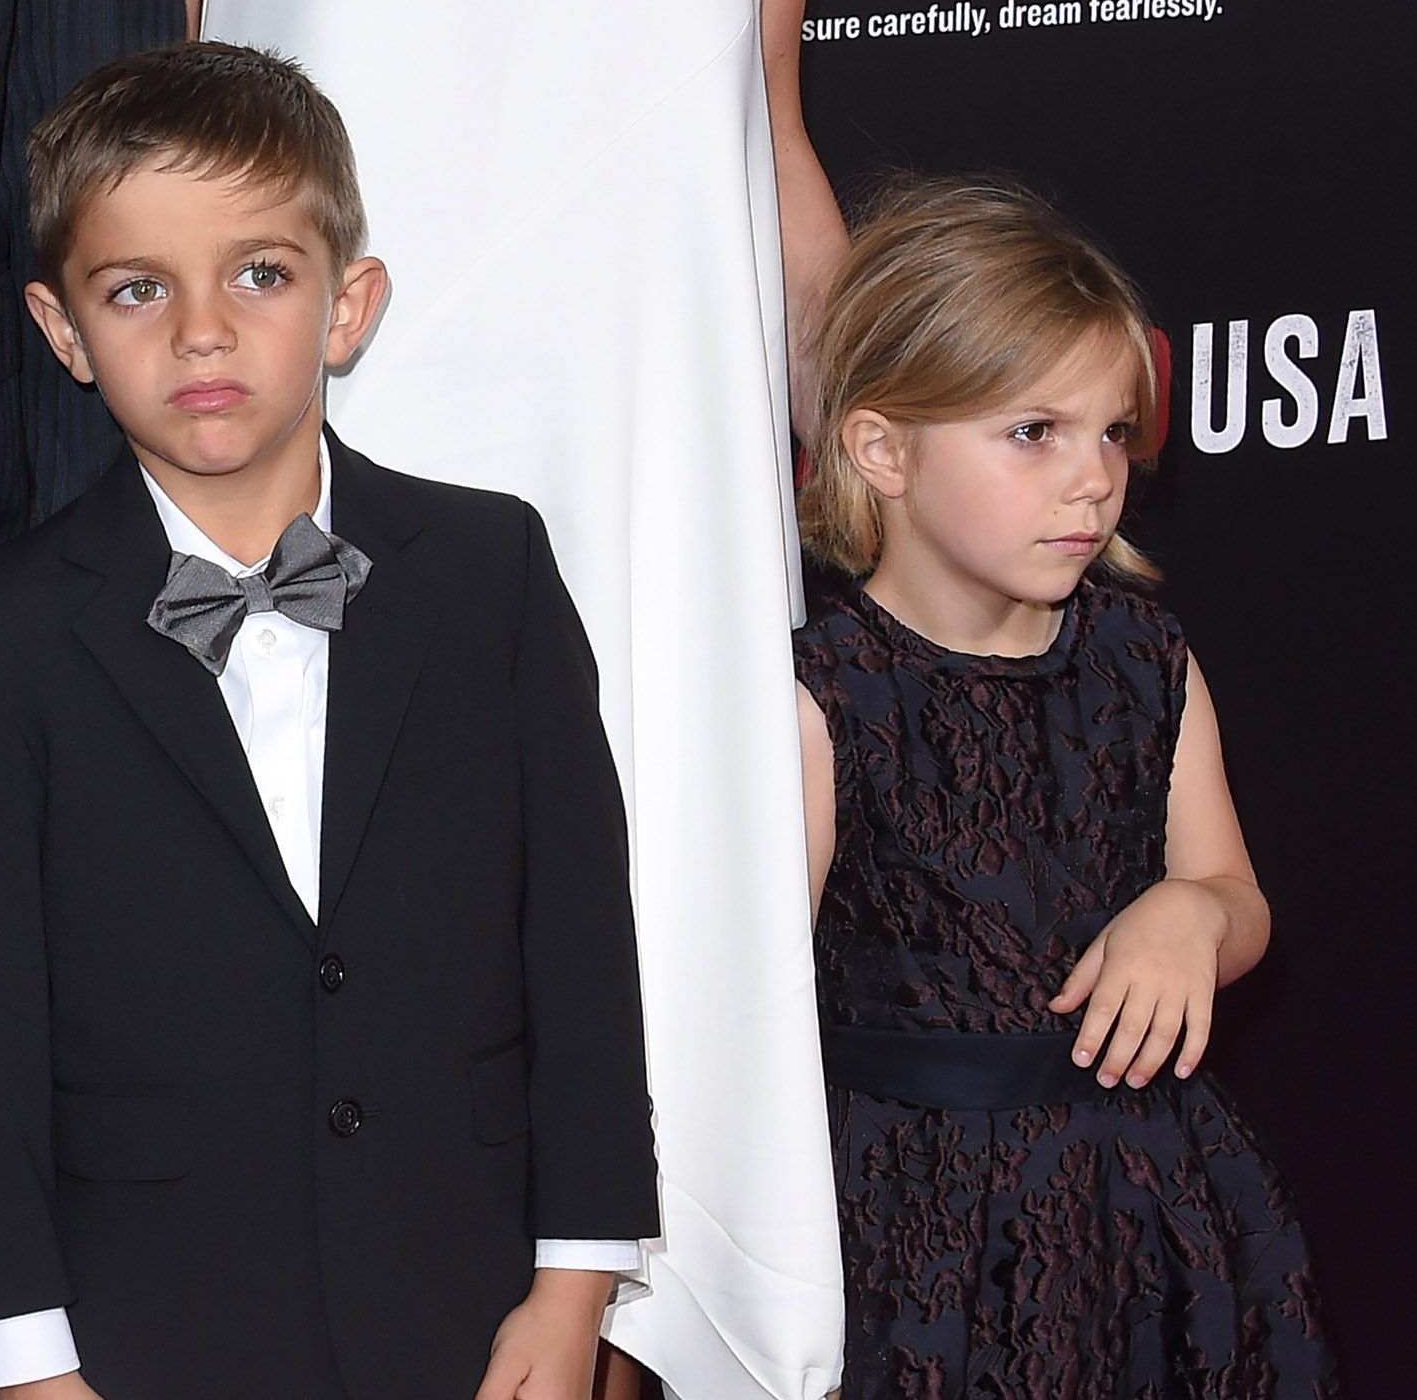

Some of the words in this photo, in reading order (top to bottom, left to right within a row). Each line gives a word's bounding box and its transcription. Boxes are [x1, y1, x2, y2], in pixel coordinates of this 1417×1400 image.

[868, 2, 991, 36] carefully,
[999, 0, 1082, 29] dream
[1191, 308, 1388, 454] USA
